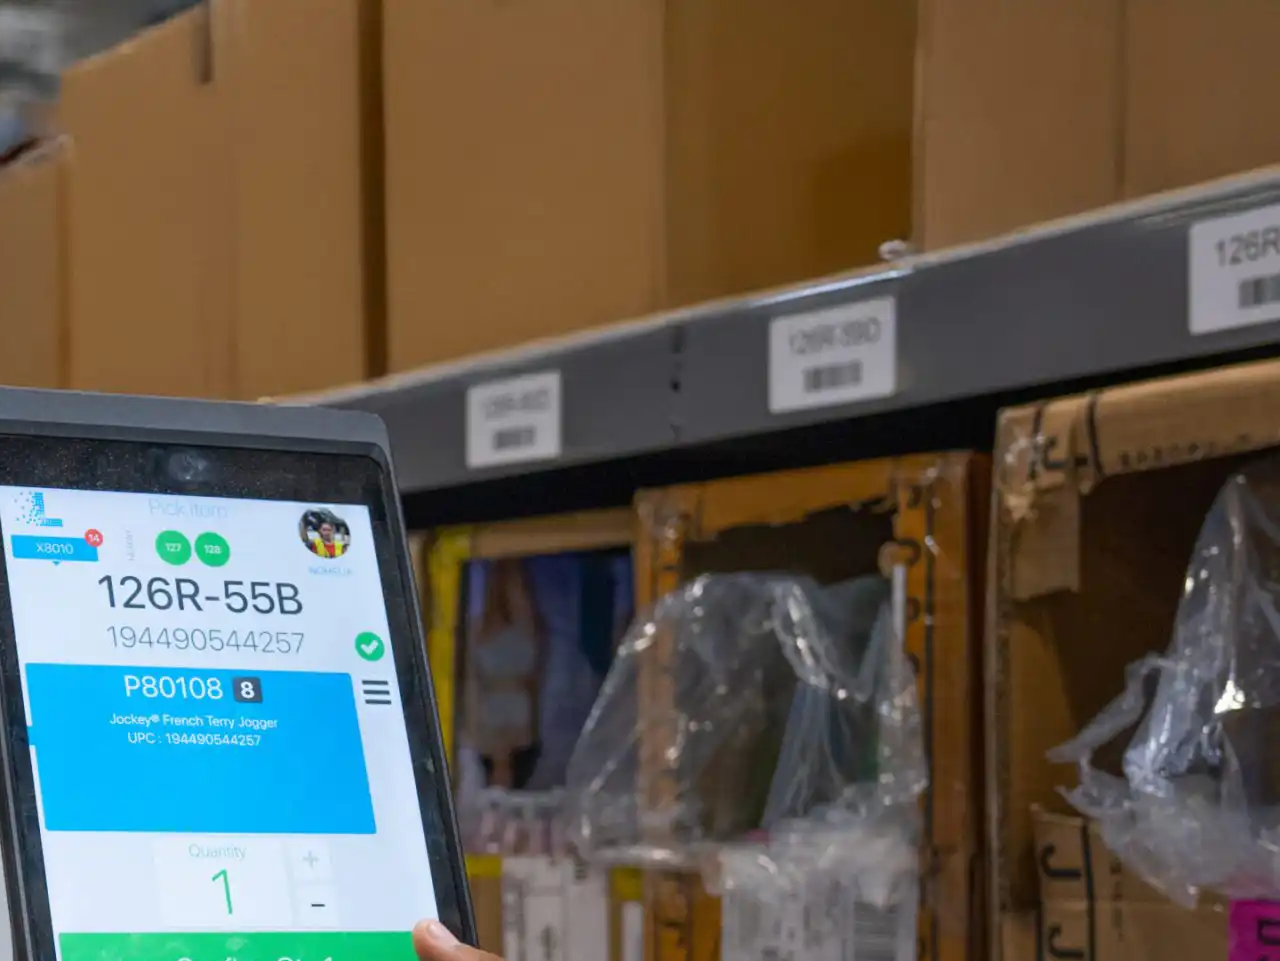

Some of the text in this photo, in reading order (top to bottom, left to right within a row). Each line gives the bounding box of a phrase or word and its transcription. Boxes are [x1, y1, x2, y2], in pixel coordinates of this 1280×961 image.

[165, 542, 182, 552] 127
[98, 575, 303, 615] 126R-55B
[106, 625, 305, 655] 194490544257
[124, 674, 255, 700] P80108 8
[163, 714, 204, 728] French
[207, 715, 235, 731] Terry
[238, 716, 278, 732] Jogger
[128, 733, 156, 745] UPC
[166, 734, 261, 748] 194490544257
[188, 843, 248, 861] Quantity
[211, 868, 234, 915] 1
